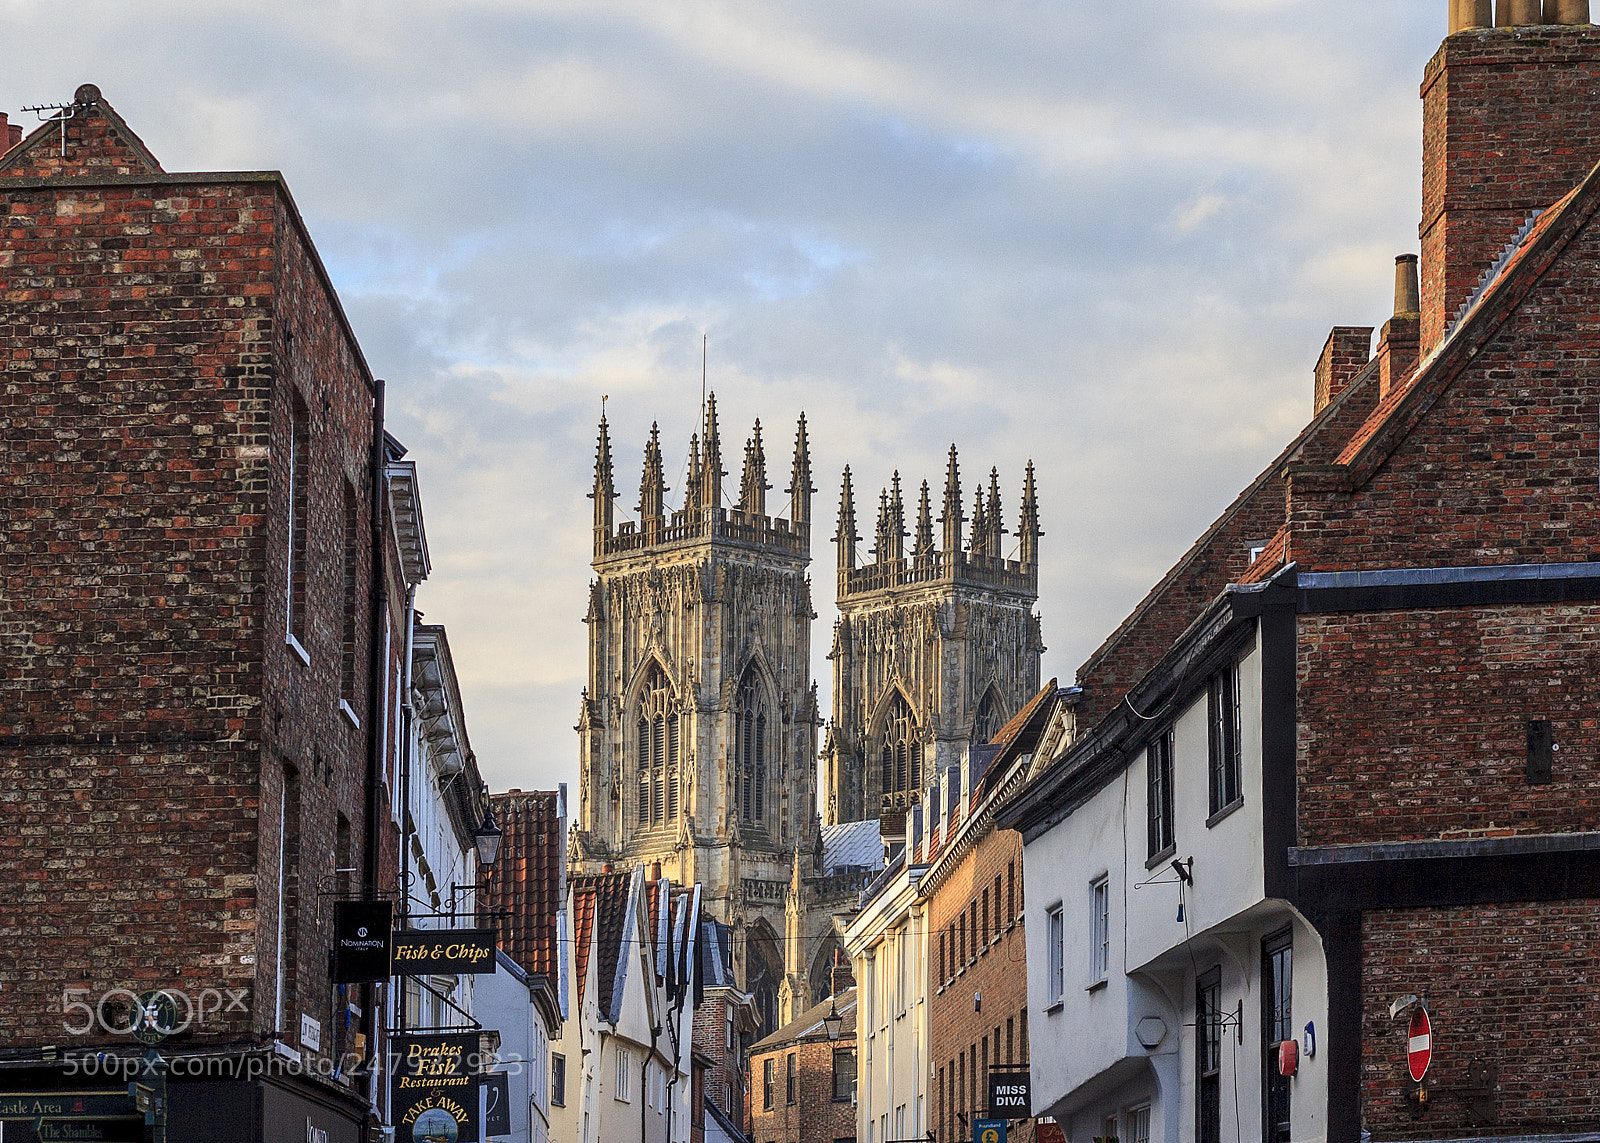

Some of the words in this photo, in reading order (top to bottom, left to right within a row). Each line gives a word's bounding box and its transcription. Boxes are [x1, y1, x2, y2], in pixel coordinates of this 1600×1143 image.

[394, 945, 428, 960] Fish
[430, 944, 444, 960] &
[445, 943, 490, 963] Chips
[407, 1042, 463, 1058] Drakes
[415, 1058, 456, 1076] Fish
[399, 1076, 469, 1089] Restaurant
[431, 1087, 445, 1097] &
[996, 1085, 1026, 1095] MISS
[0, 1100, 28, 1114] astle
[32, 1100, 62, 1114] Area
[996, 1096, 1026, 1106] DIVA
[402, 1096, 434, 1124] TAKE
[436, 1096, 469, 1123] AWAY
[43, 1124, 60, 1138] The
